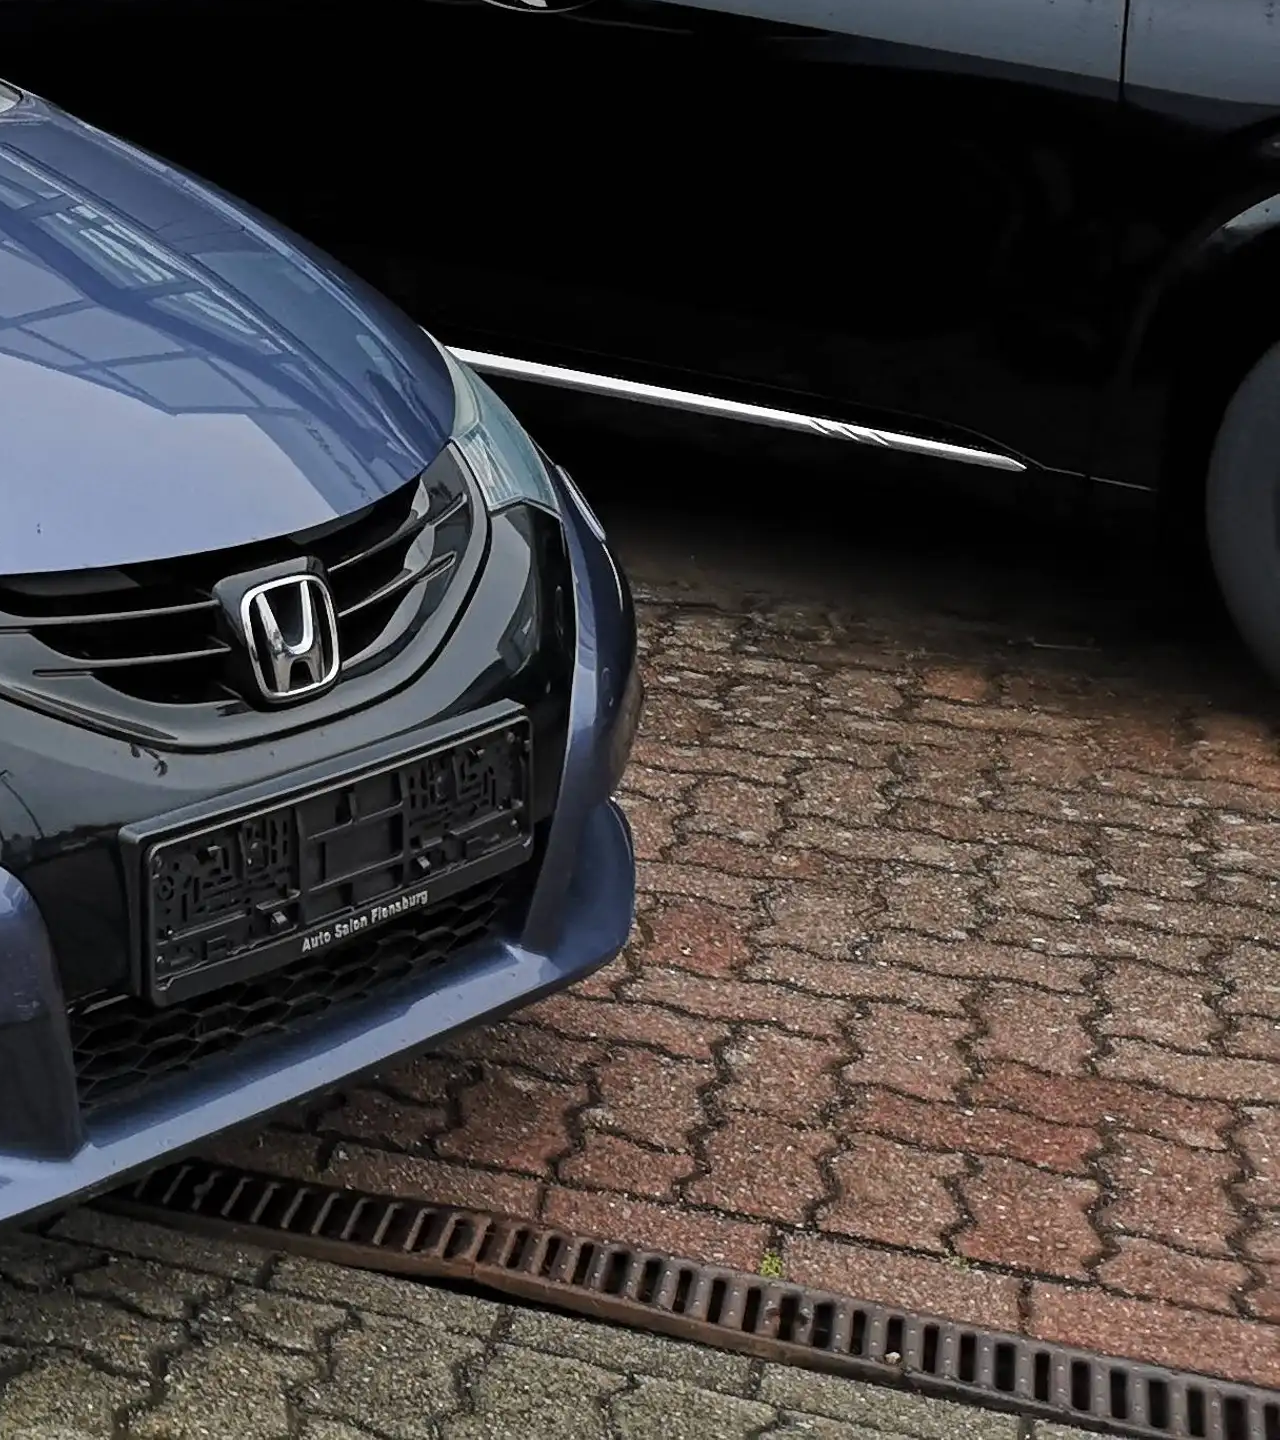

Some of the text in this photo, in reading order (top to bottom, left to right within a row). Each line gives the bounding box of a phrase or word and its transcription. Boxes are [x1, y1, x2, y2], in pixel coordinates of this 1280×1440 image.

[302, 891, 428, 952] Auto Salon Flensburg
